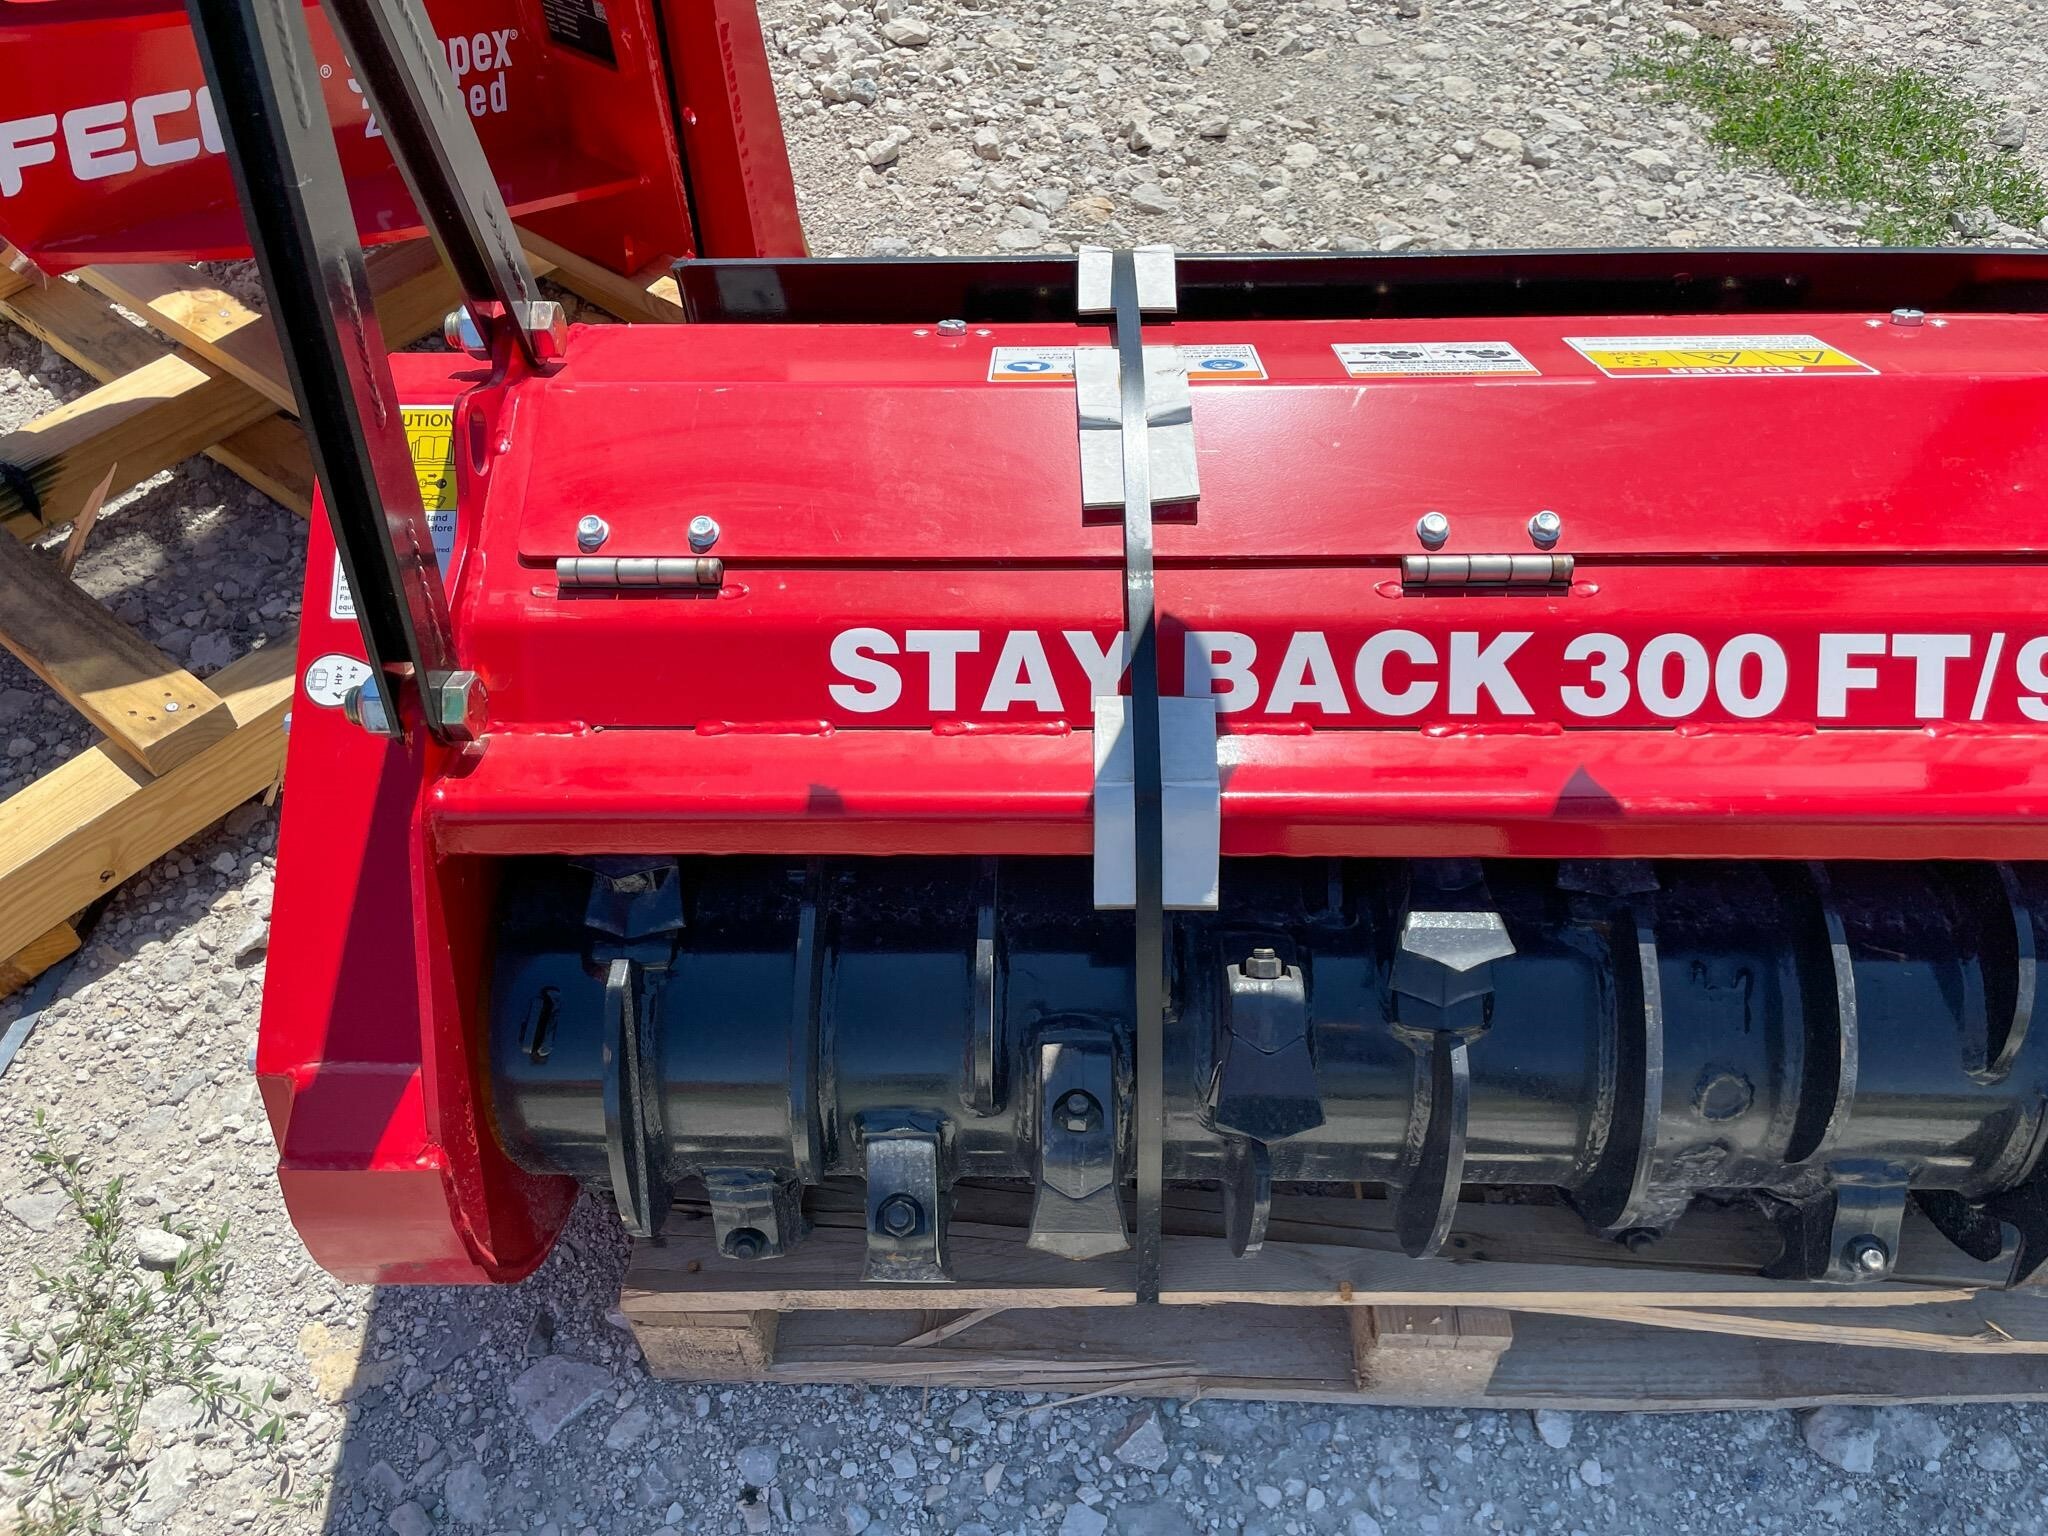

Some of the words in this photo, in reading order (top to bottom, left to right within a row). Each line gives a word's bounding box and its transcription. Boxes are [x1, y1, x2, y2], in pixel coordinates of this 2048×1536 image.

[1667, 366, 1786, 375] DANGER
[402, 413, 454, 427] UTION
[1183, 628, 1536, 716] BACK
[1560, 632, 1789, 719] 300
